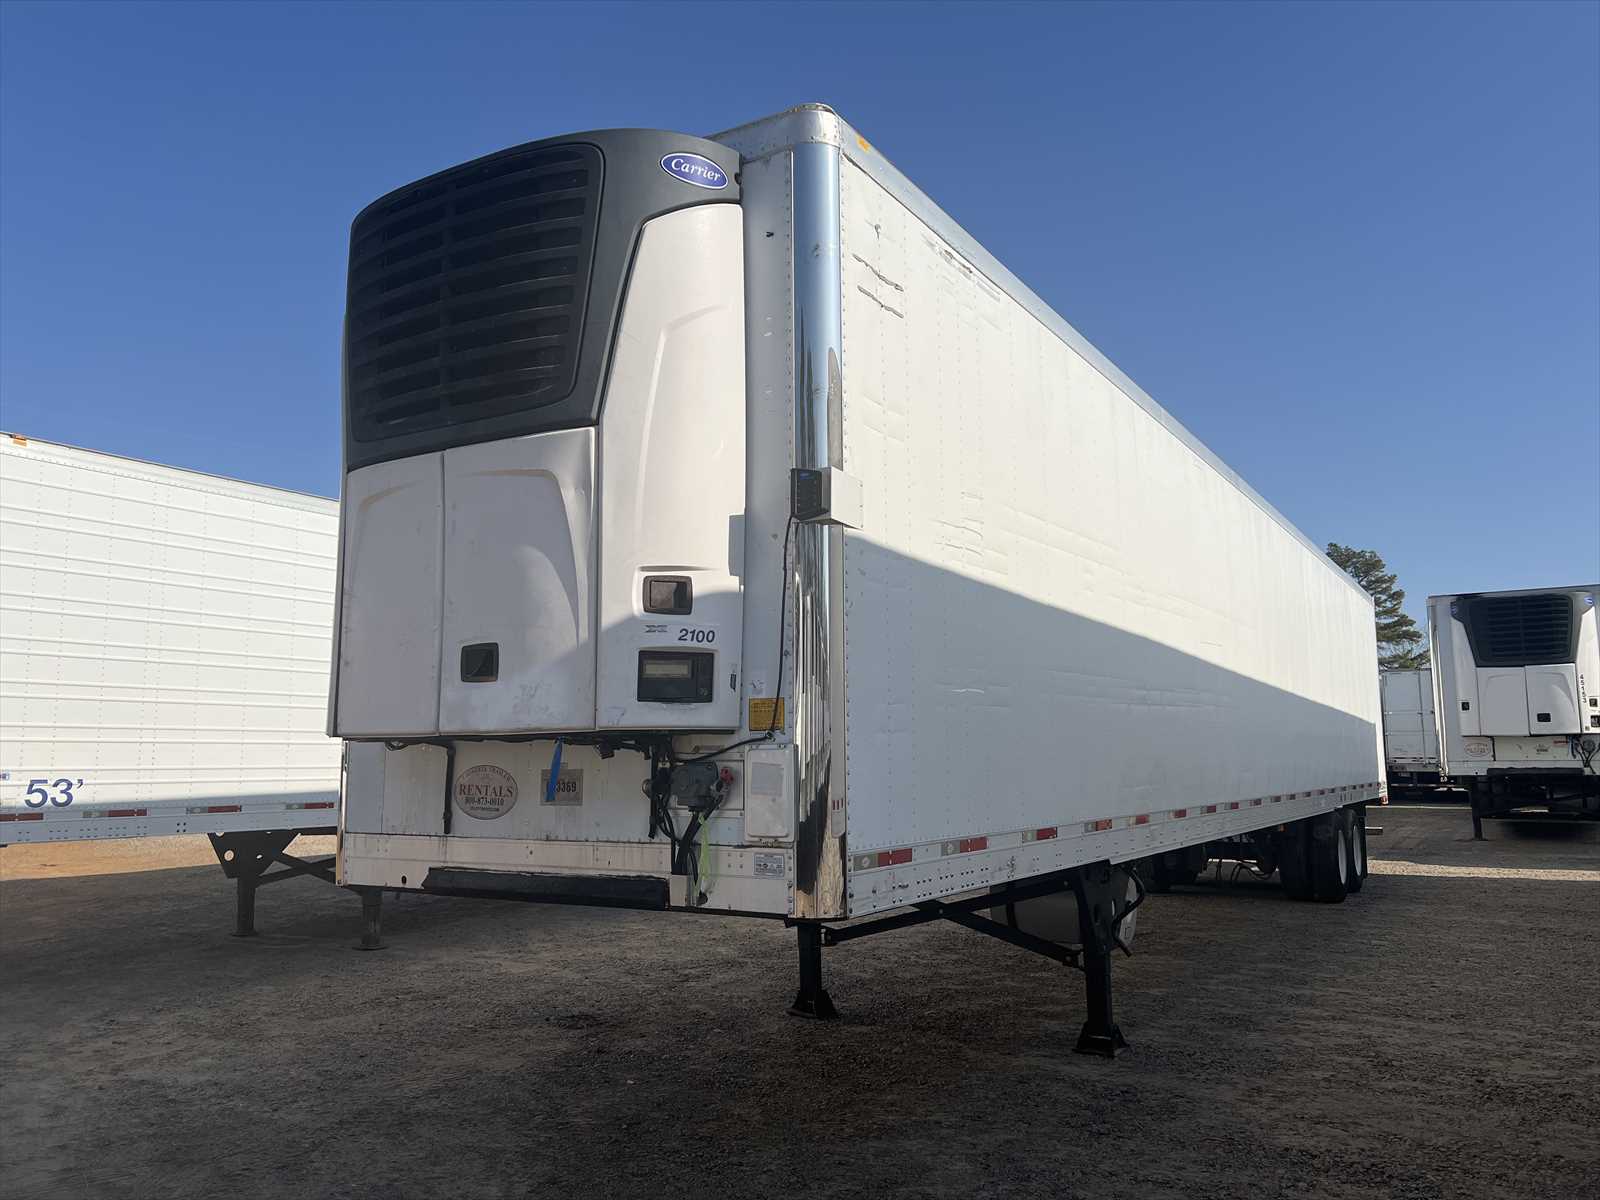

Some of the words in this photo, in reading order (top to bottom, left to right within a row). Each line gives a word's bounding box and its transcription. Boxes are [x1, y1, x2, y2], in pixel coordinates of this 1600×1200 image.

[671, 158, 721, 181] Carrier
[678, 628, 715, 643] 2100
[459, 783, 513, 798] RENTALS
